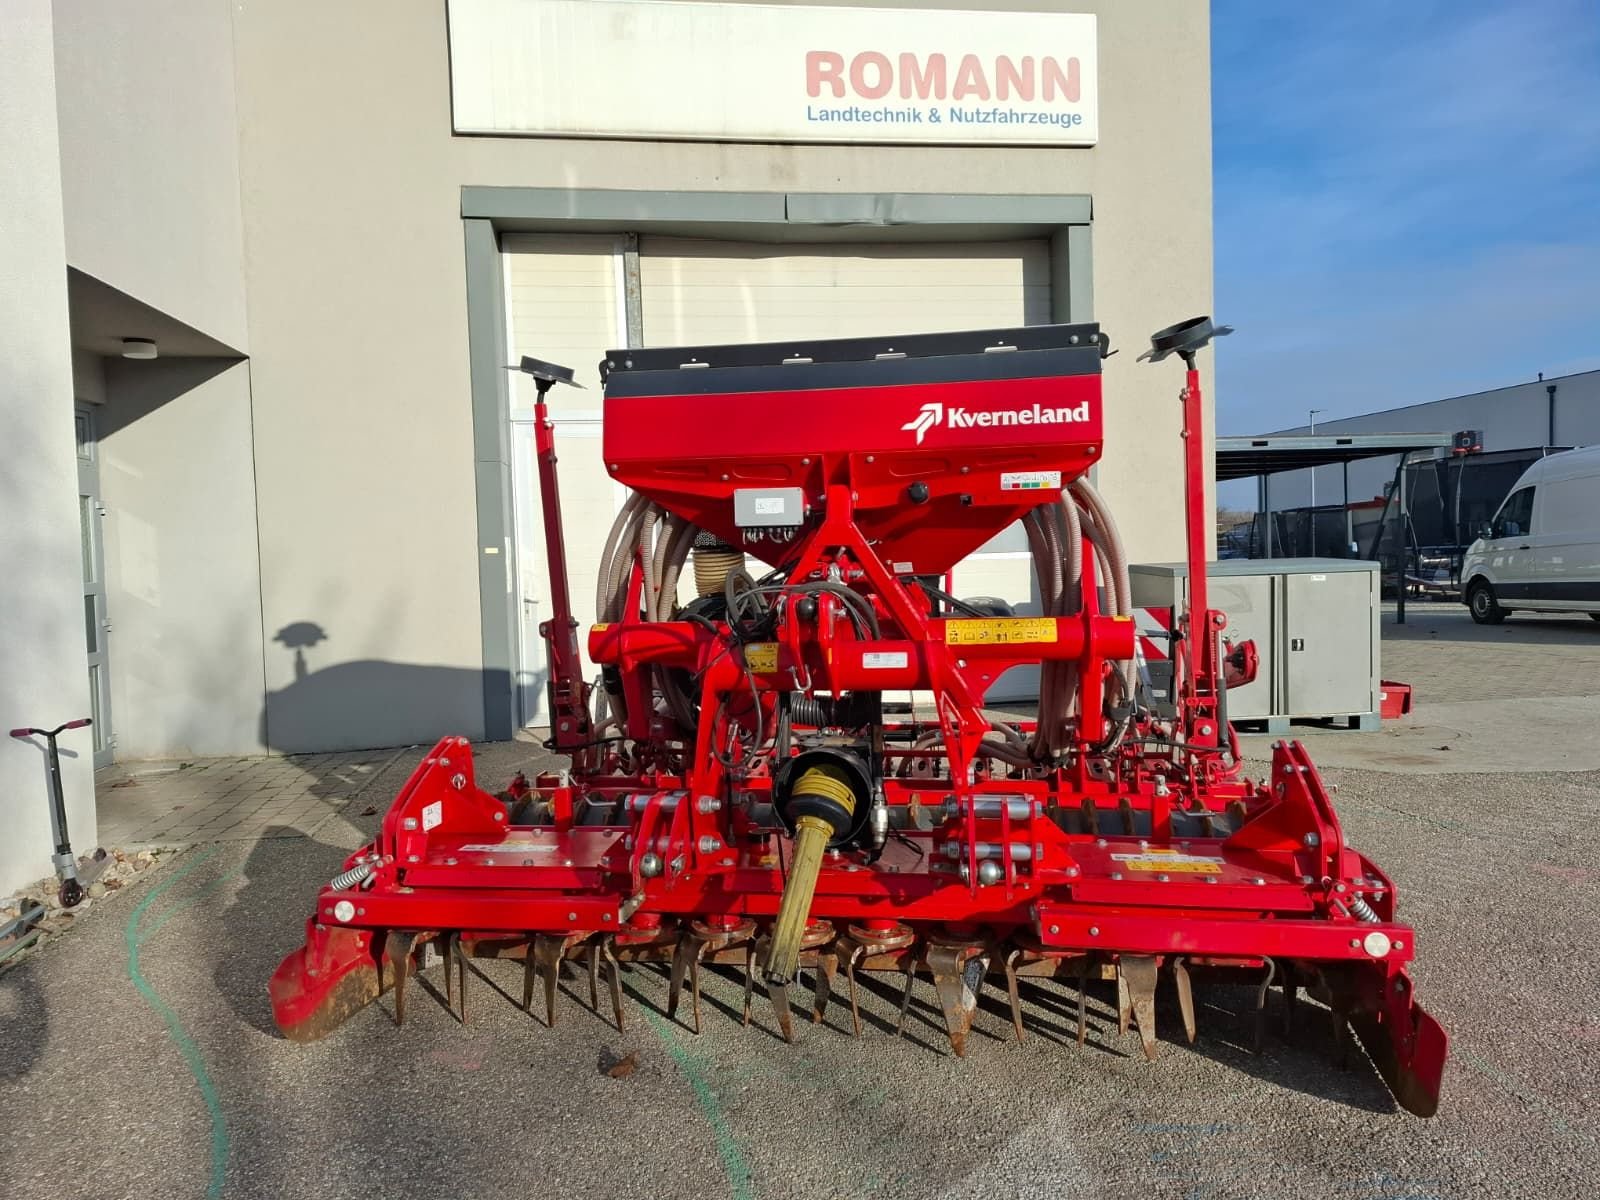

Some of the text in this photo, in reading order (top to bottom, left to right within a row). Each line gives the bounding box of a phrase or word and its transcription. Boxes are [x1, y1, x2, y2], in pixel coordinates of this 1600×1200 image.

[806, 50, 1080, 102] ROMANN
[807, 105, 1082, 128] Landtechnik & Nutzfahrzeuge
[948, 401, 1090, 428] Kverneland
